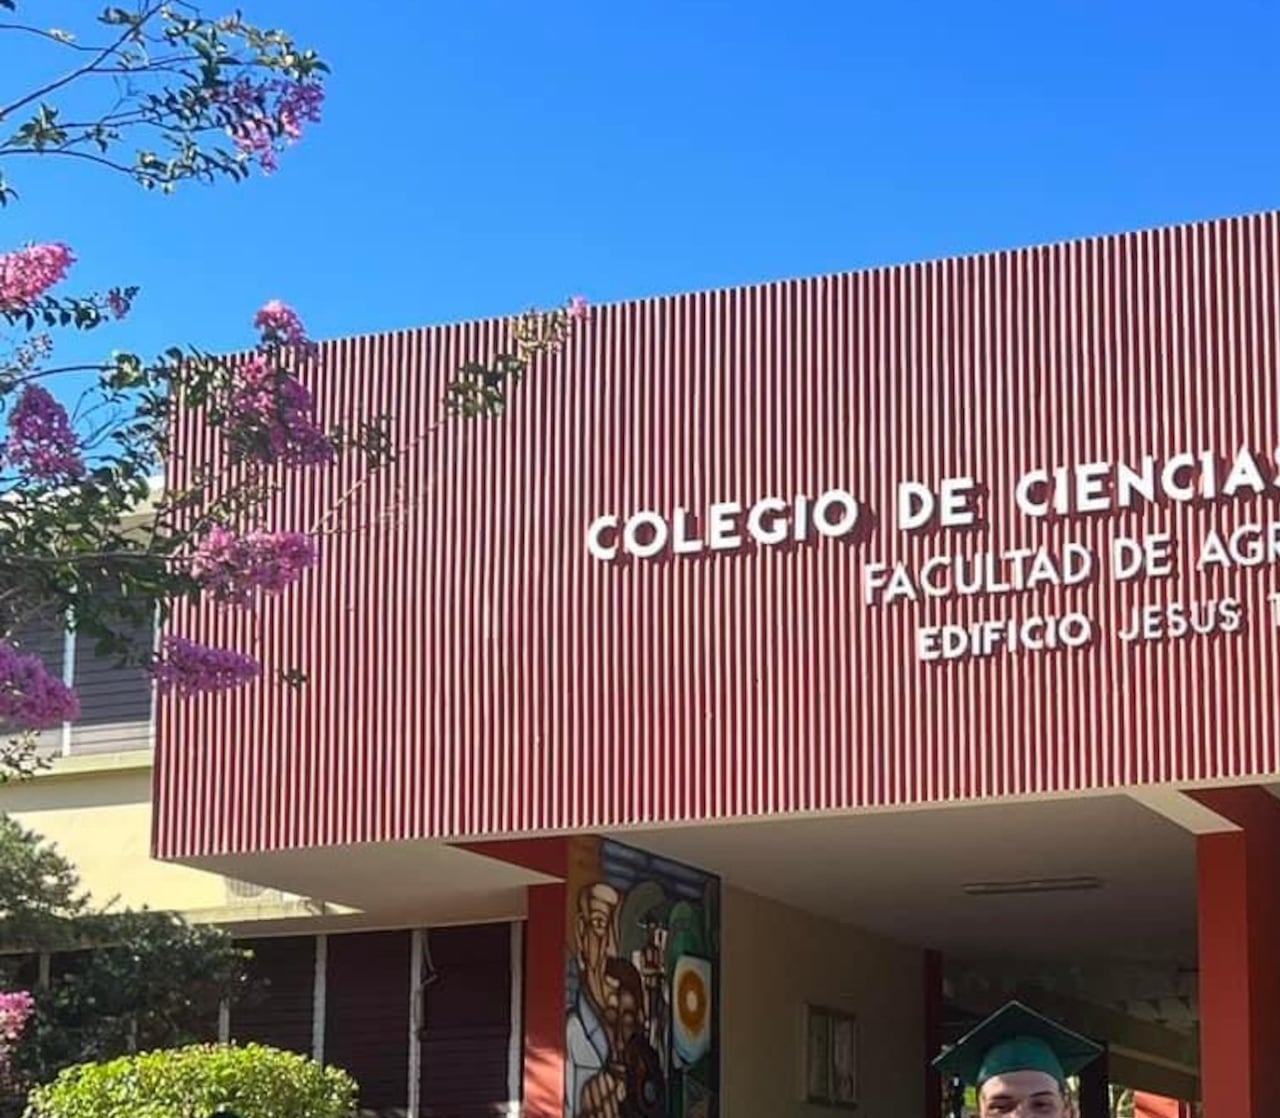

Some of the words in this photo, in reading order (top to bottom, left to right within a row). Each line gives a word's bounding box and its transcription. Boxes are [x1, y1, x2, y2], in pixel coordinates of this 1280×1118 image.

[588, 488, 858, 561] COLEGIO
[899, 477, 975, 530] DE
[864, 542, 1091, 604] FACULTAD
[1114, 533, 1172, 581] DE
[919, 612, 1092, 661] EDIFICIO
[1118, 596, 1240, 641] JESUS
